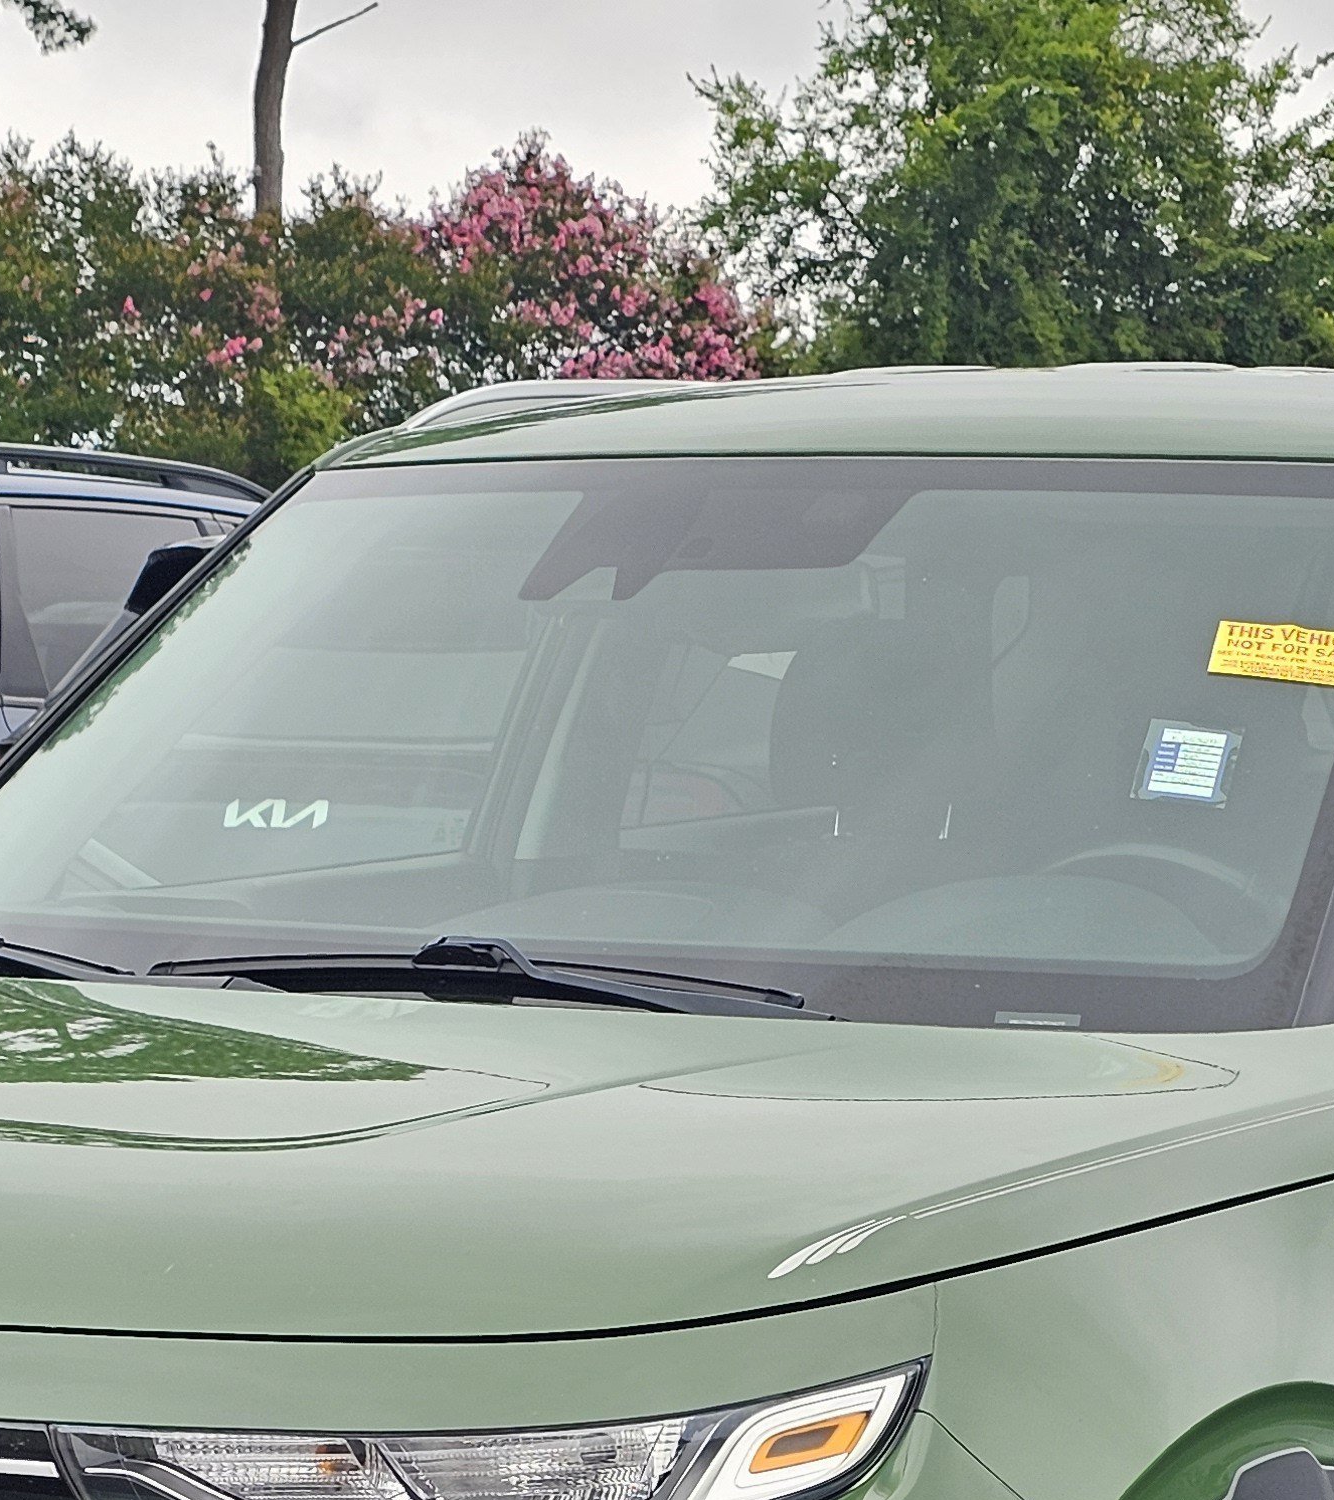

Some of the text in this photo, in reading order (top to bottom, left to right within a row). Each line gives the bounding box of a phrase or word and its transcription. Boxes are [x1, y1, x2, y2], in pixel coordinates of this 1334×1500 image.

[1227, 624, 1275, 640] THIS
[1227, 638, 1266, 651] NOT
[1271, 643, 1309, 657] FOR
[223, 798, 329, 829] KIA
